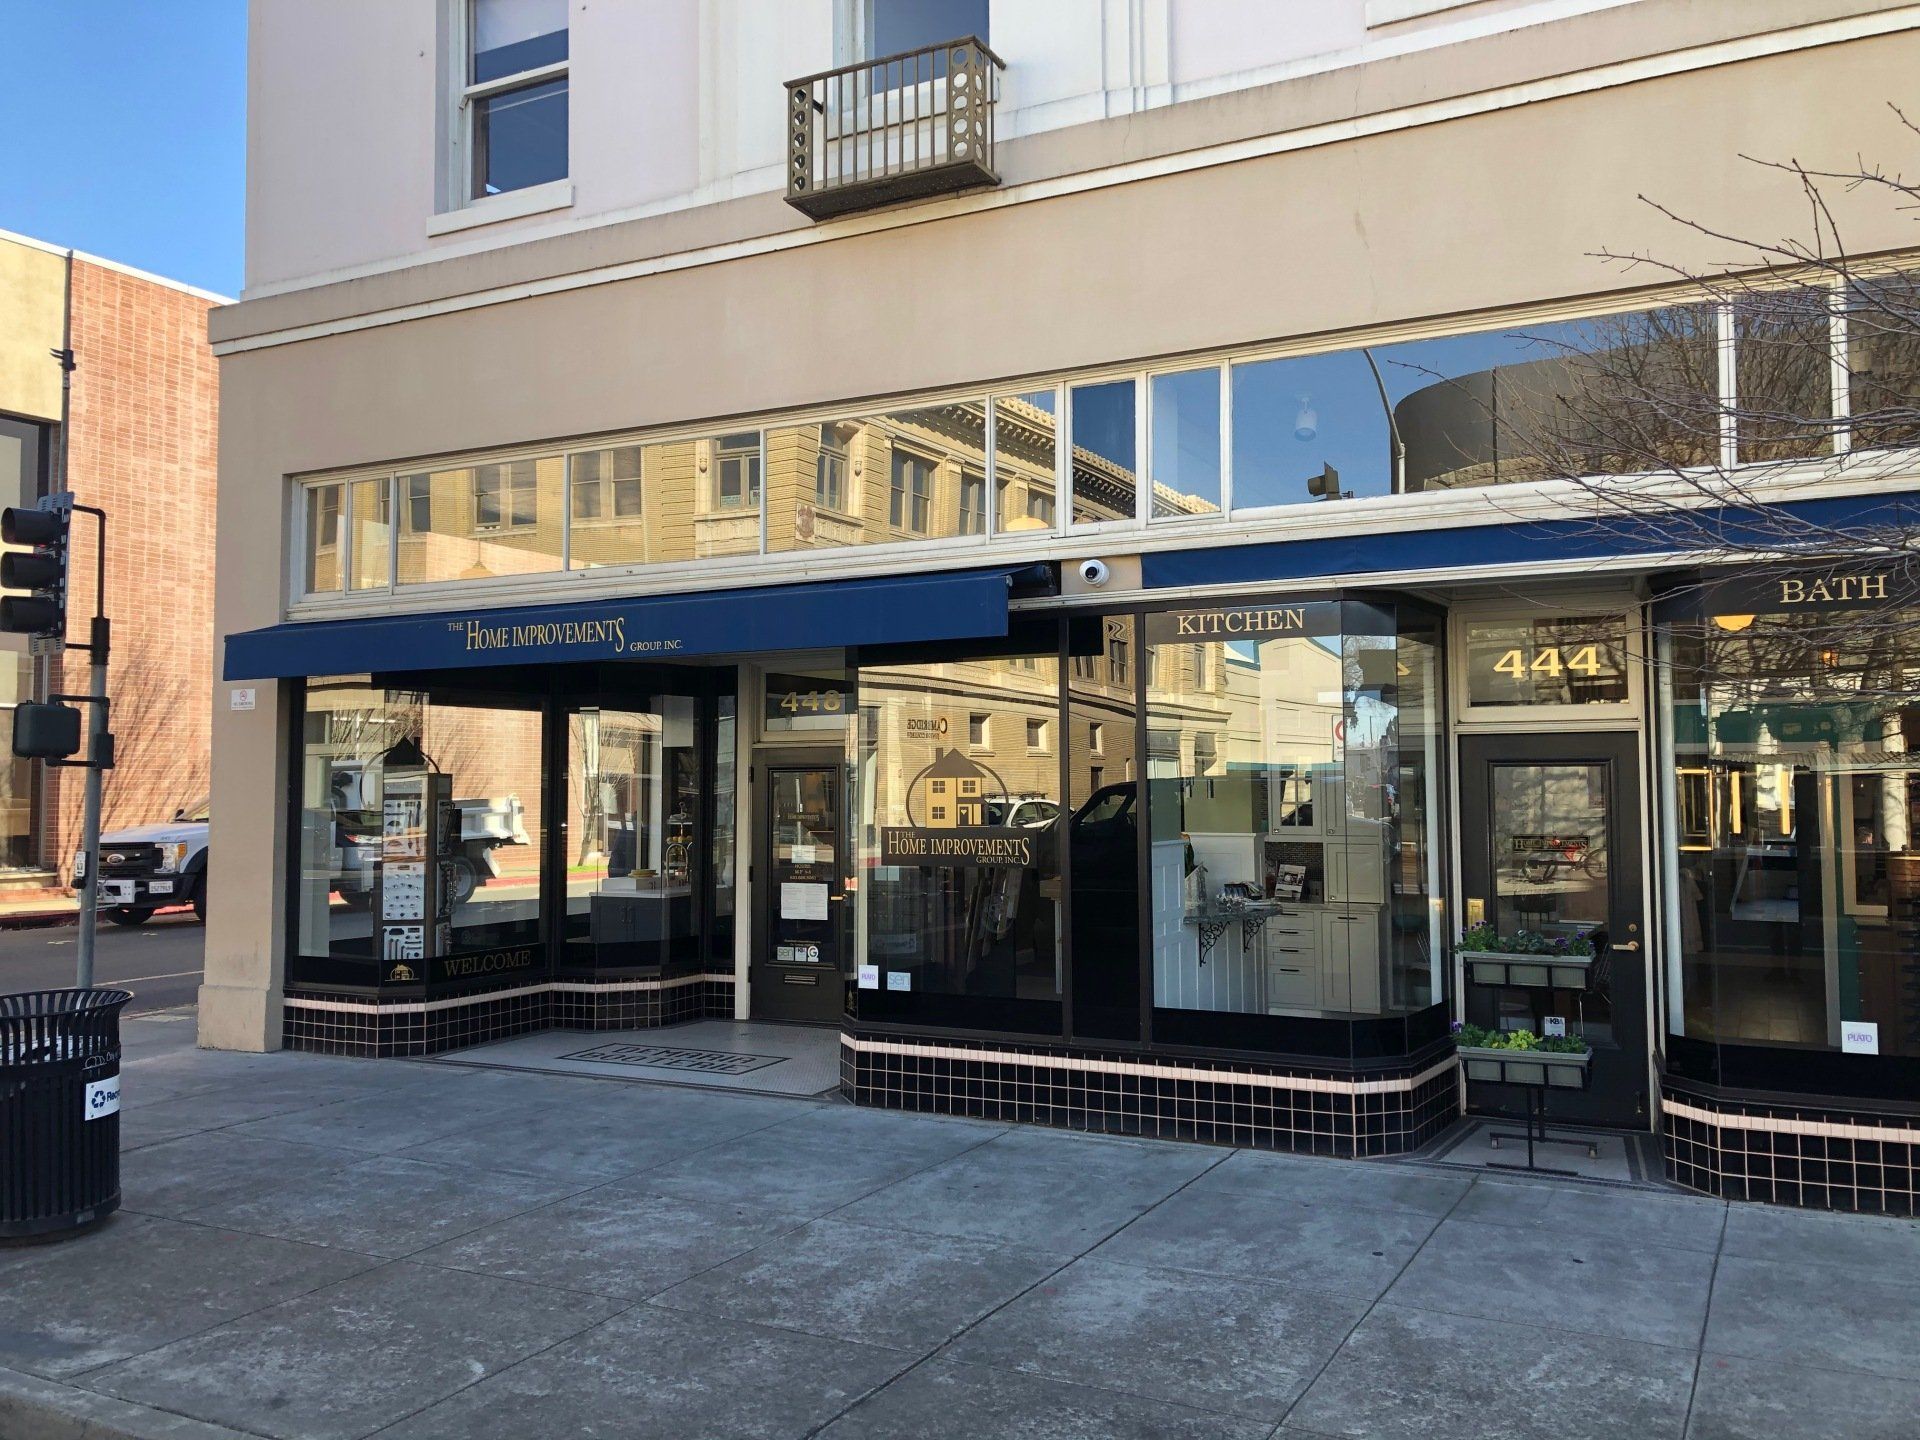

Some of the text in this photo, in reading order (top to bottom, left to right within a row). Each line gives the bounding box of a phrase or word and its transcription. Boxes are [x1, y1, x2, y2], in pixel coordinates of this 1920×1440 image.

[1779, 574, 1888, 603] BATH
[447, 622, 464, 631] THE
[466, 620, 508, 650] HOME
[512, 617, 625, 652] IMPROVEMENTS
[1176, 608, 1306, 635] KITCHEN
[1493, 645, 1601, 678] 444
[780, 690, 841, 712] 448
[888, 831, 1030, 866] HOME IMPROVEMENTS
[444, 950, 531, 977] WELCOME
[888, 974, 910, 986] sen
[1847, 1033, 1873, 1043] PLATO
[576, 1052, 751, 1072] BOOTERIE
[612, 1045, 757, 1064] DEMARIA
